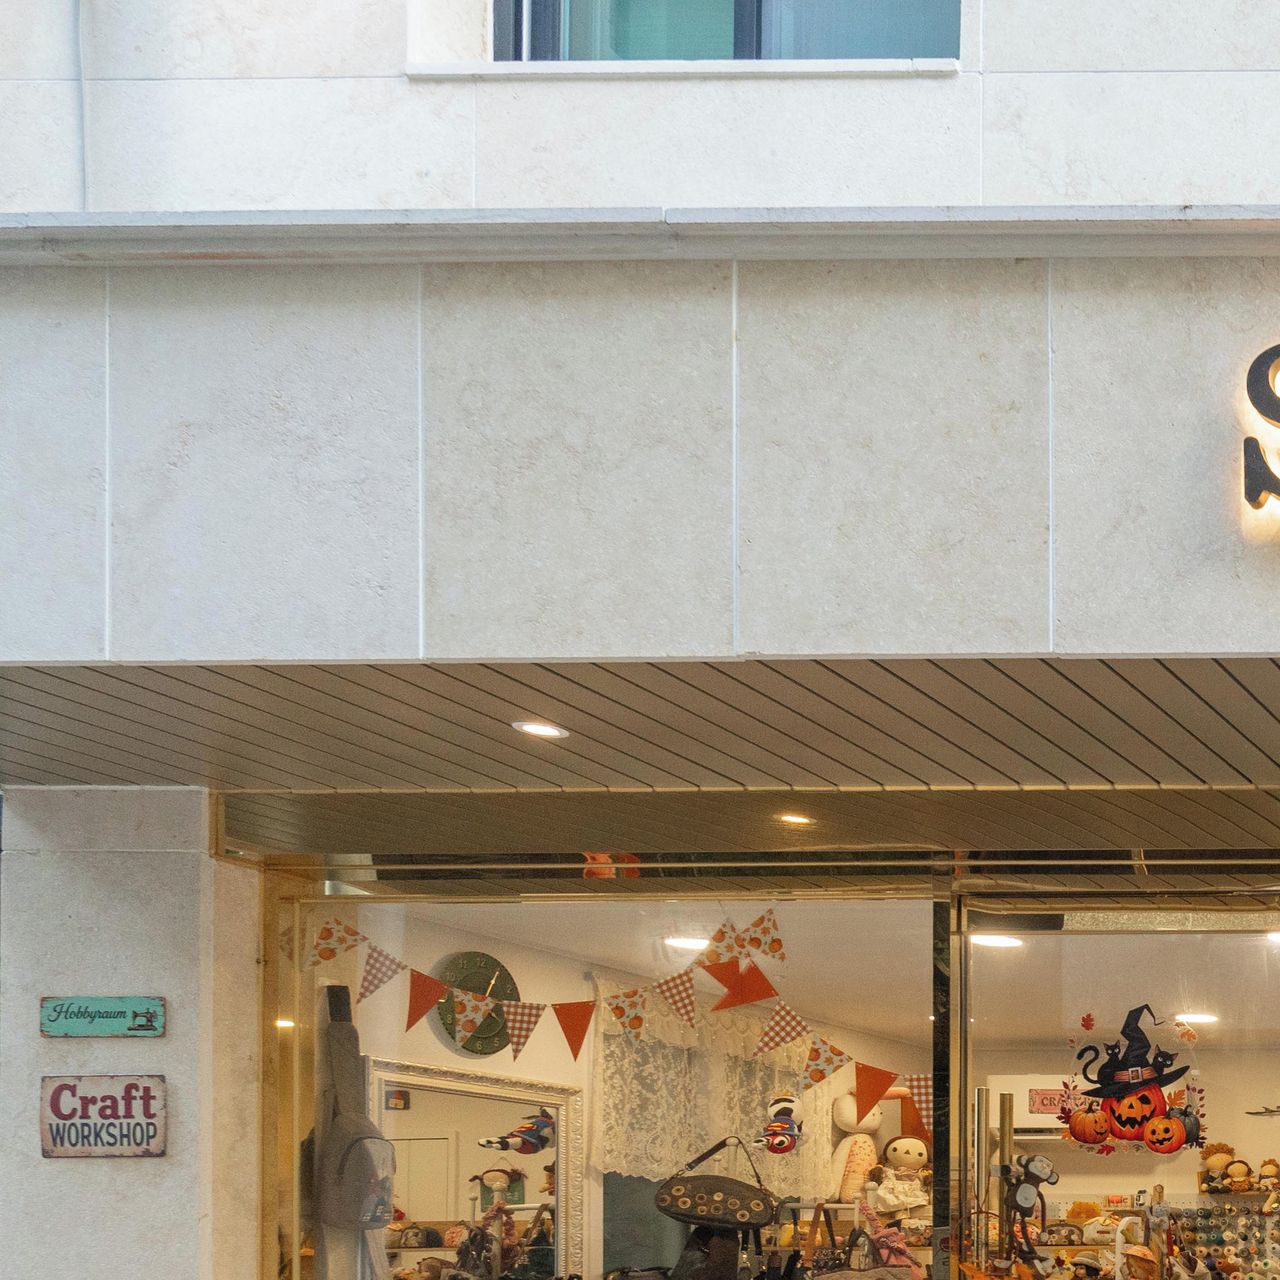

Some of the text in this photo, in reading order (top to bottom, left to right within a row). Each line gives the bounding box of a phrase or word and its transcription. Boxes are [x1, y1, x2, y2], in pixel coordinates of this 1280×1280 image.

[47, 1002, 128, 1024] Hobbyraum
[50, 1083, 157, 1121] Craft
[48, 1121, 157, 1148] WORKSHOP
